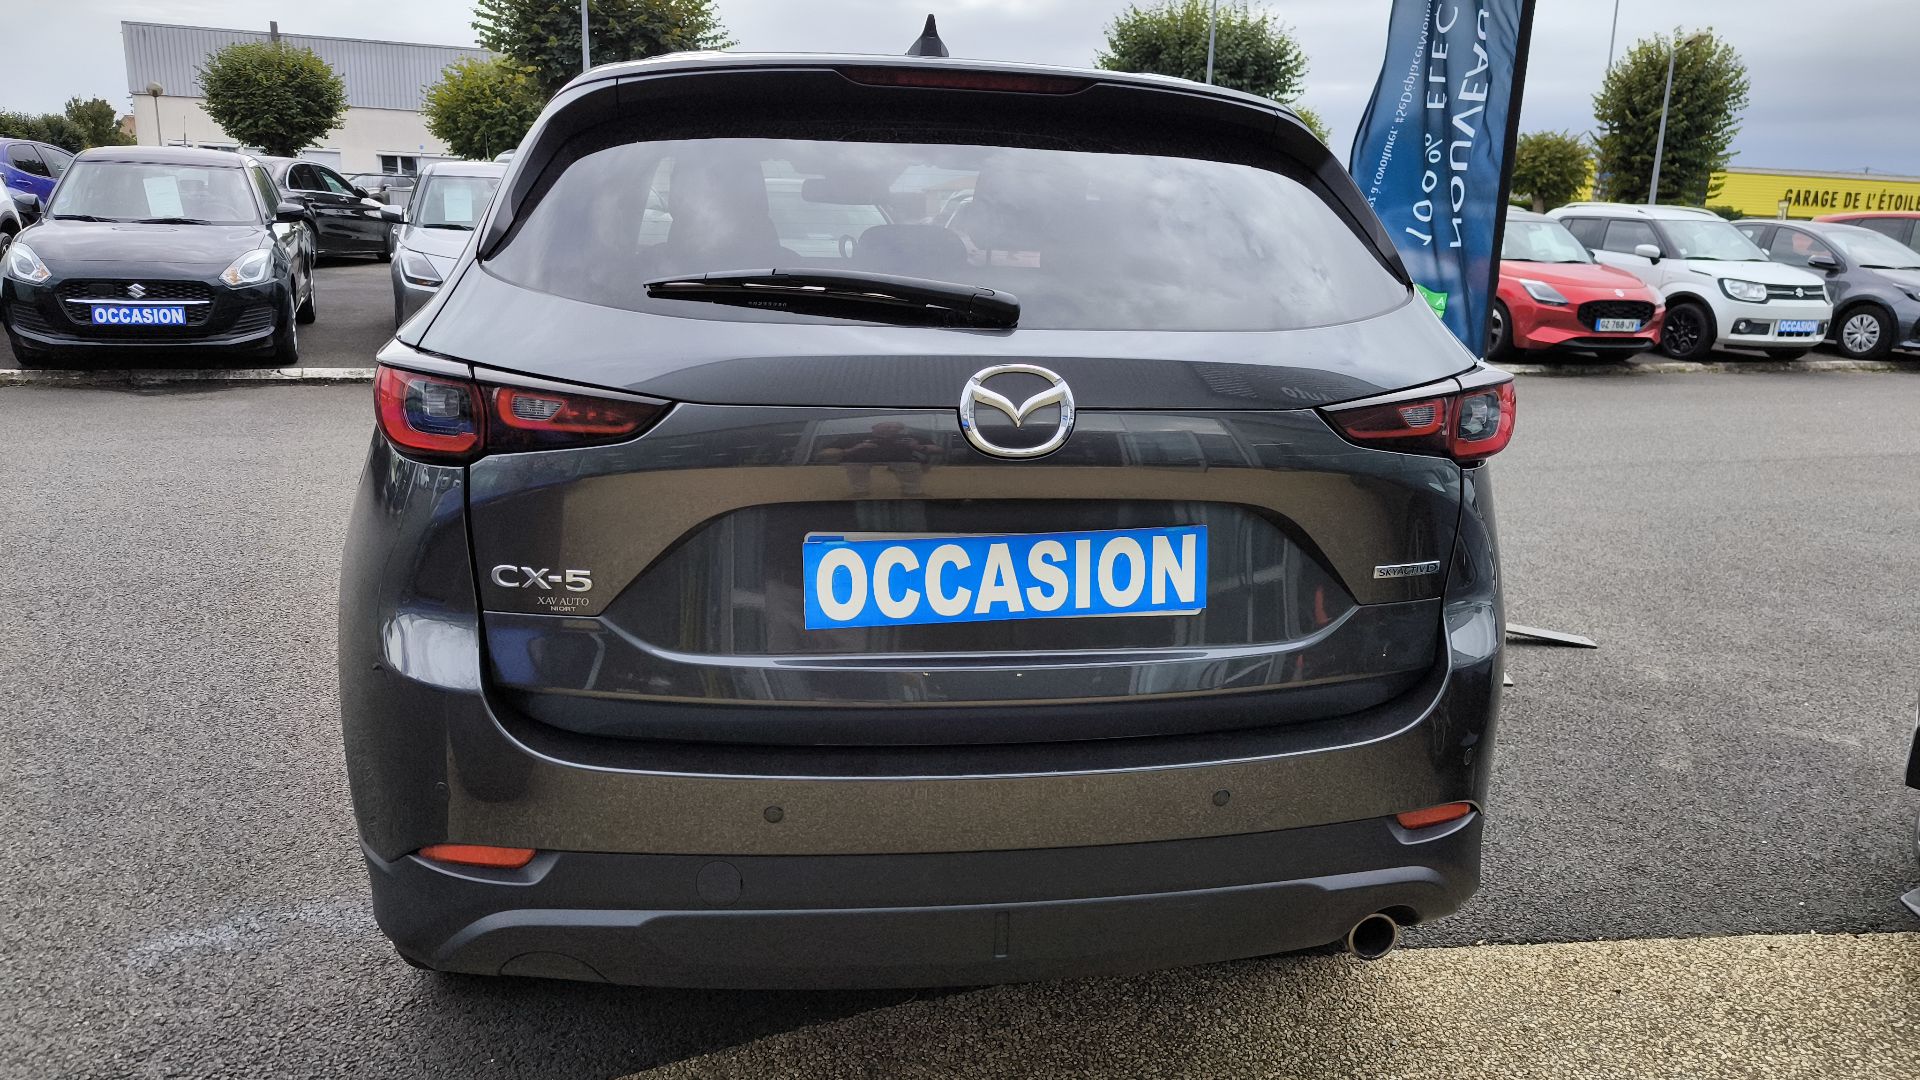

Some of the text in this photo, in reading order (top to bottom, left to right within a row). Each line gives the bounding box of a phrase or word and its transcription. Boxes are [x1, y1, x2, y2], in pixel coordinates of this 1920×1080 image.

[1784, 188, 1838, 208] GARAGE
[1843, 192, 1861, 209] DE
[94, 307, 184, 324] OCCASION
[1780, 320, 1817, 332] OCCASION
[490, 564, 593, 592] CX-5
[816, 534, 1197, 621] OCCASION
[537, 596, 590, 606] XAV AUTO
